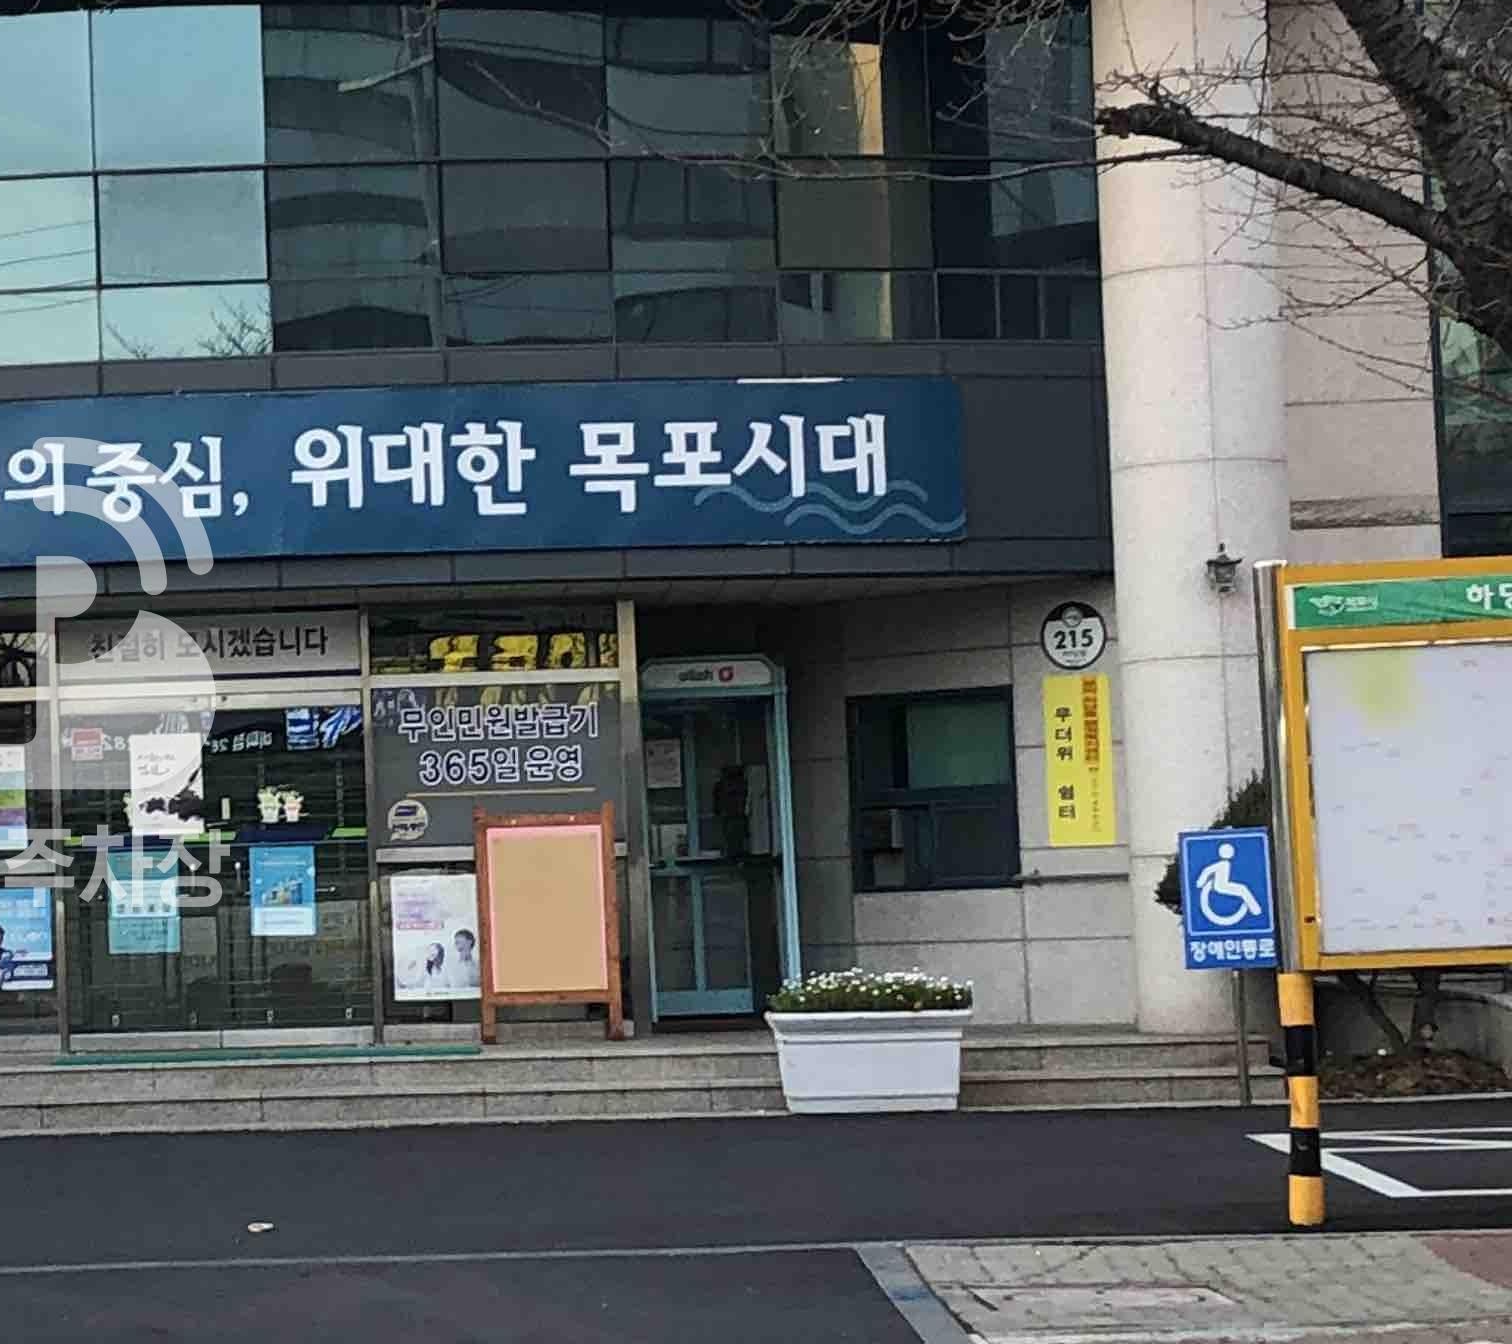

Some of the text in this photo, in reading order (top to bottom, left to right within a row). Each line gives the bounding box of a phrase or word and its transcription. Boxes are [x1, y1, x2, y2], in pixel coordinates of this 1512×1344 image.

[85, 434, 250, 523] 중심,
[291, 419, 536, 516] 위대한
[569, 413, 887, 513] 목포시대
[88, 625, 329, 662] 친절히 모시겠습니다
[1053, 628, 1094, 650] 215
[398, 701, 600, 744] 무인민원발급기
[419, 744, 583, 786] 365일 운영
[1054, 706, 1077, 820] 무더위 쉼터
[1189, 937, 1277, 963] 장애인통로
